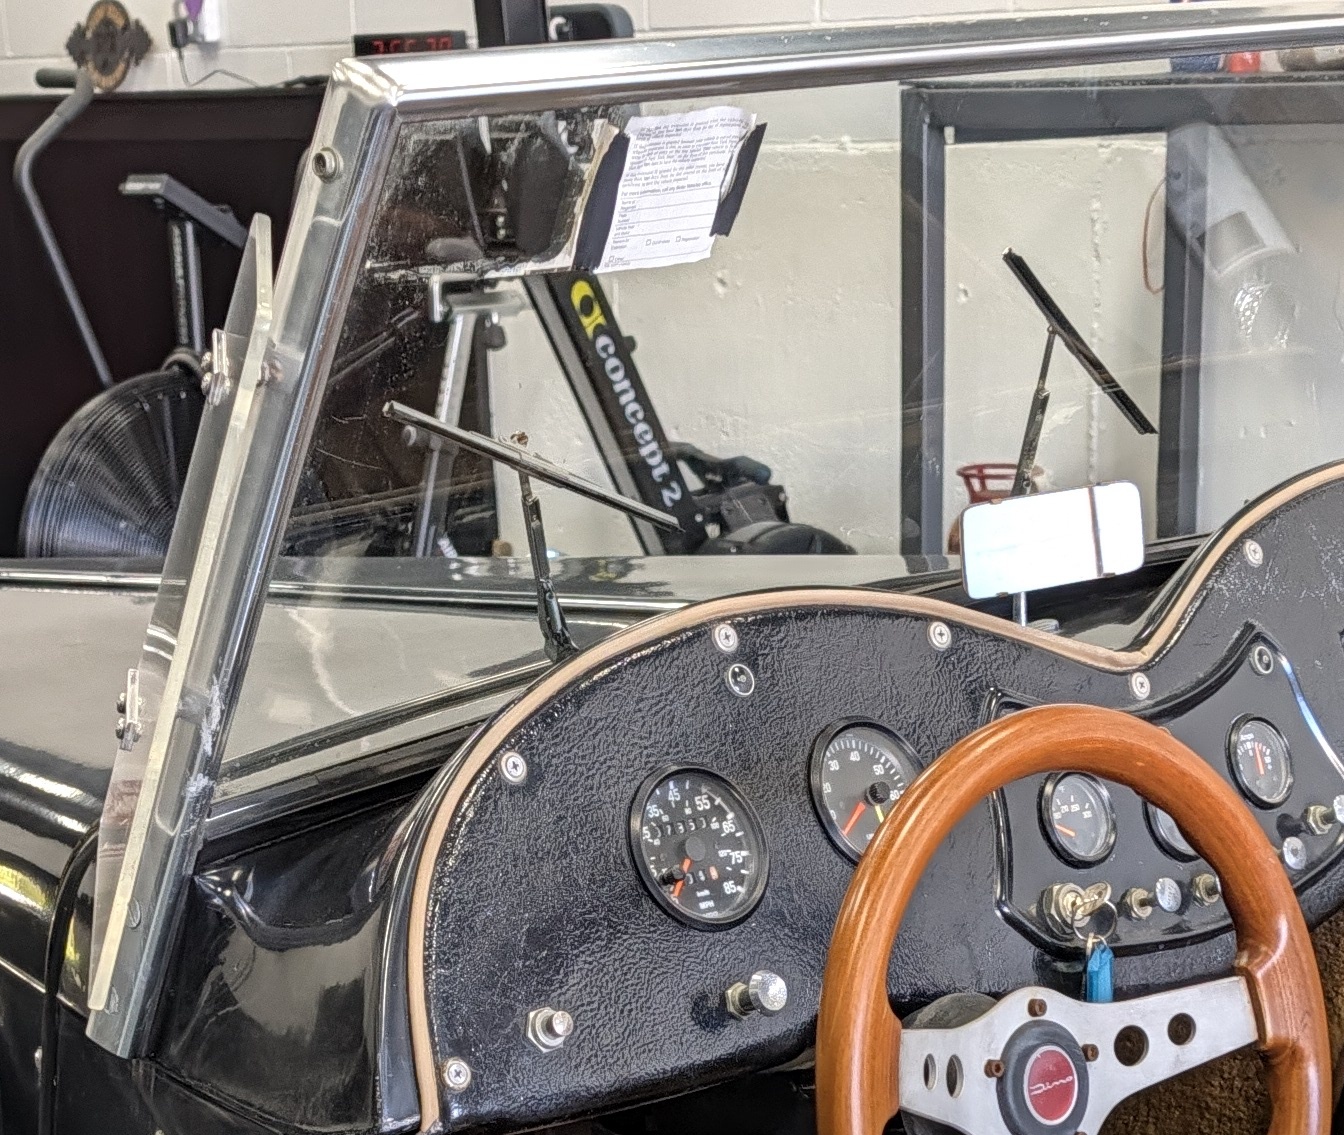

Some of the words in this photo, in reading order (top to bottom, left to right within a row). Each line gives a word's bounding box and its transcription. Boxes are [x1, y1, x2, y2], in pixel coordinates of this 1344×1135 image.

[661, 480, 682, 508] 2
[849, 750, 861, 762] 40
[827, 760, 840, 772] 30
[872, 763, 885, 775] 50
[667, 788, 681, 801] 45
[889, 789, 901, 801] 60
[694, 794, 711, 811] 55
[646, 804, 660, 818] 35
[722, 819, 736, 834] 65
[729, 851, 743, 865] 75
[723, 880, 737, 894] 85
